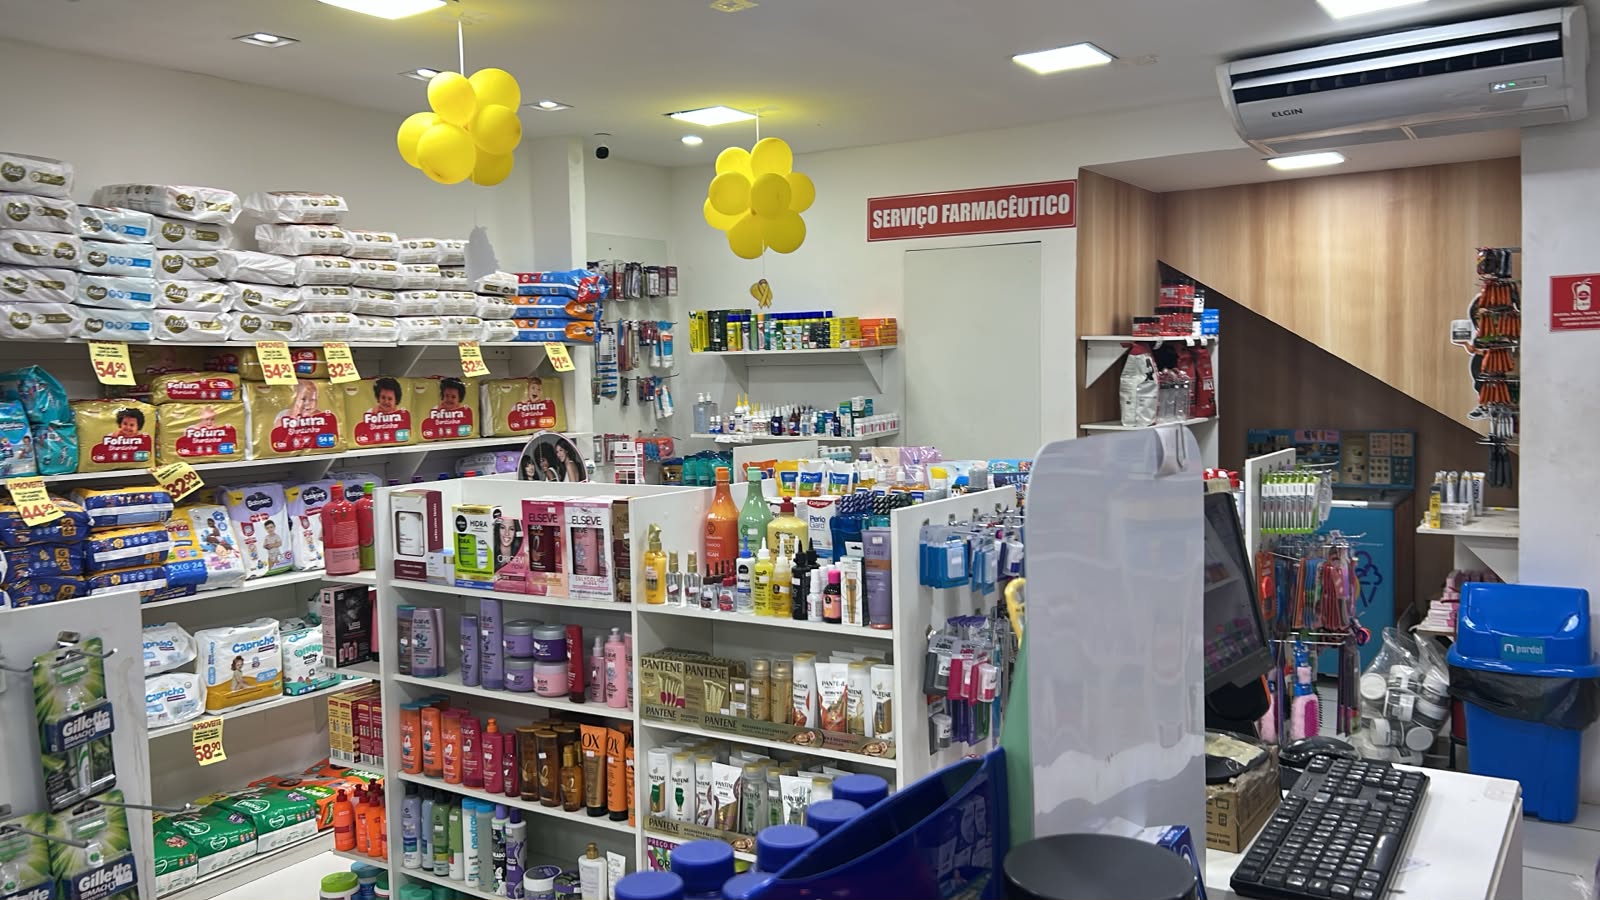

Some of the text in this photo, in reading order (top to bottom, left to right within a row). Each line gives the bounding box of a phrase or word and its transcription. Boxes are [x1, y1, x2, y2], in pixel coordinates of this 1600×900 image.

[1271, 107, 1304, 118] ELGIN
[872, 193, 1071, 229] SERVIÇO FARMACÊUTICO
[364, 413, 403, 424] Fofura
[429, 409, 465, 420] Fofura
[282, 416, 326, 429] Fofura
[186, 427, 227, 439] Fofura
[103, 435, 144, 447] Fofura
[808, 499, 830, 507] Colgate
[469, 520, 488, 528] HIDRA
[528, 512, 559, 524] ELSEVE
[571, 515, 602, 526] ELSEVE
[809, 515, 826, 523] Perio
[142, 639, 174, 650] apricho
[231, 635, 276, 654] Capricho
[641, 658, 683, 673] PANTENE
[685, 664, 727, 680] PANTENE
[145, 687, 186, 703] Capricho
[645, 706, 677, 719] PANTENE
[62, 710, 111, 738] Gillette
[704, 715, 737, 729] PANTENE
[582, 732, 600, 750] OX
[607, 736, 620, 754] OX
[648, 817, 681, 832] PANTENE
[78, 862, 132, 892] Gillette
